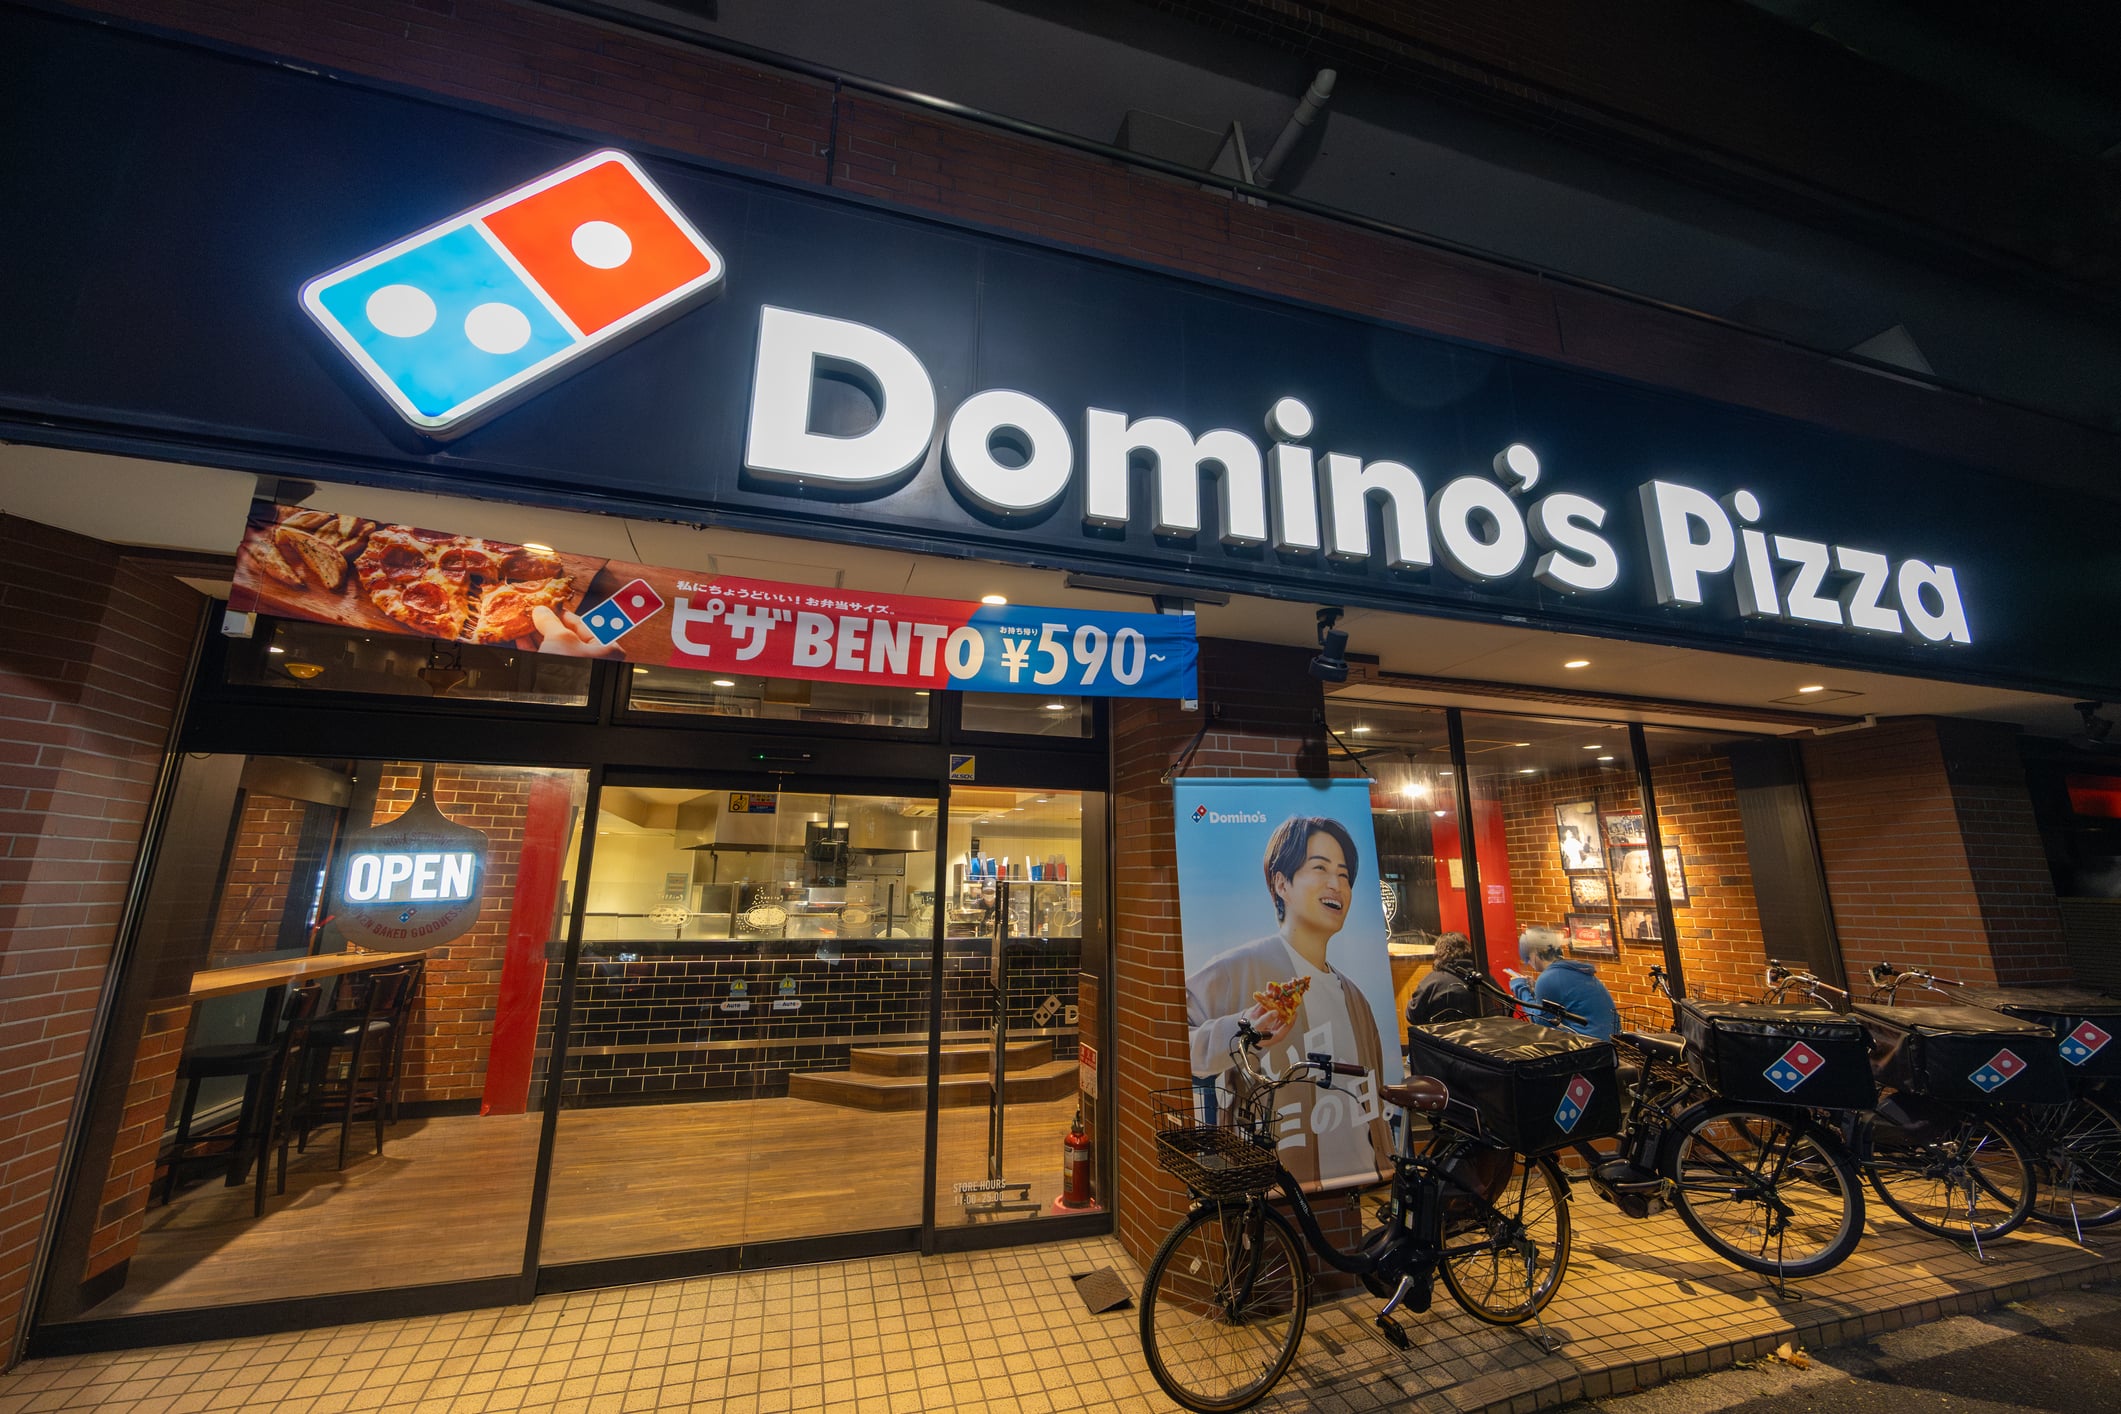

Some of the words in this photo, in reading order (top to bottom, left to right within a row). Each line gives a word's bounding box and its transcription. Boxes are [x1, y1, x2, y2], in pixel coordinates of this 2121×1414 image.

[744, 304, 1619, 592] Domino's
[1640, 479, 1971, 645] Pizza
[999, 626, 1038, 636] お持ち帰り
[1209, 810, 1267, 824] Domino's
[348, 854, 472, 901] OPEN
[373, 923, 408, 939] BAKED
[411, 905, 463, 938] GOODNESS
[953, 1181, 978, 1193] STORE
[980, 1178, 1006, 1191] HOURS
